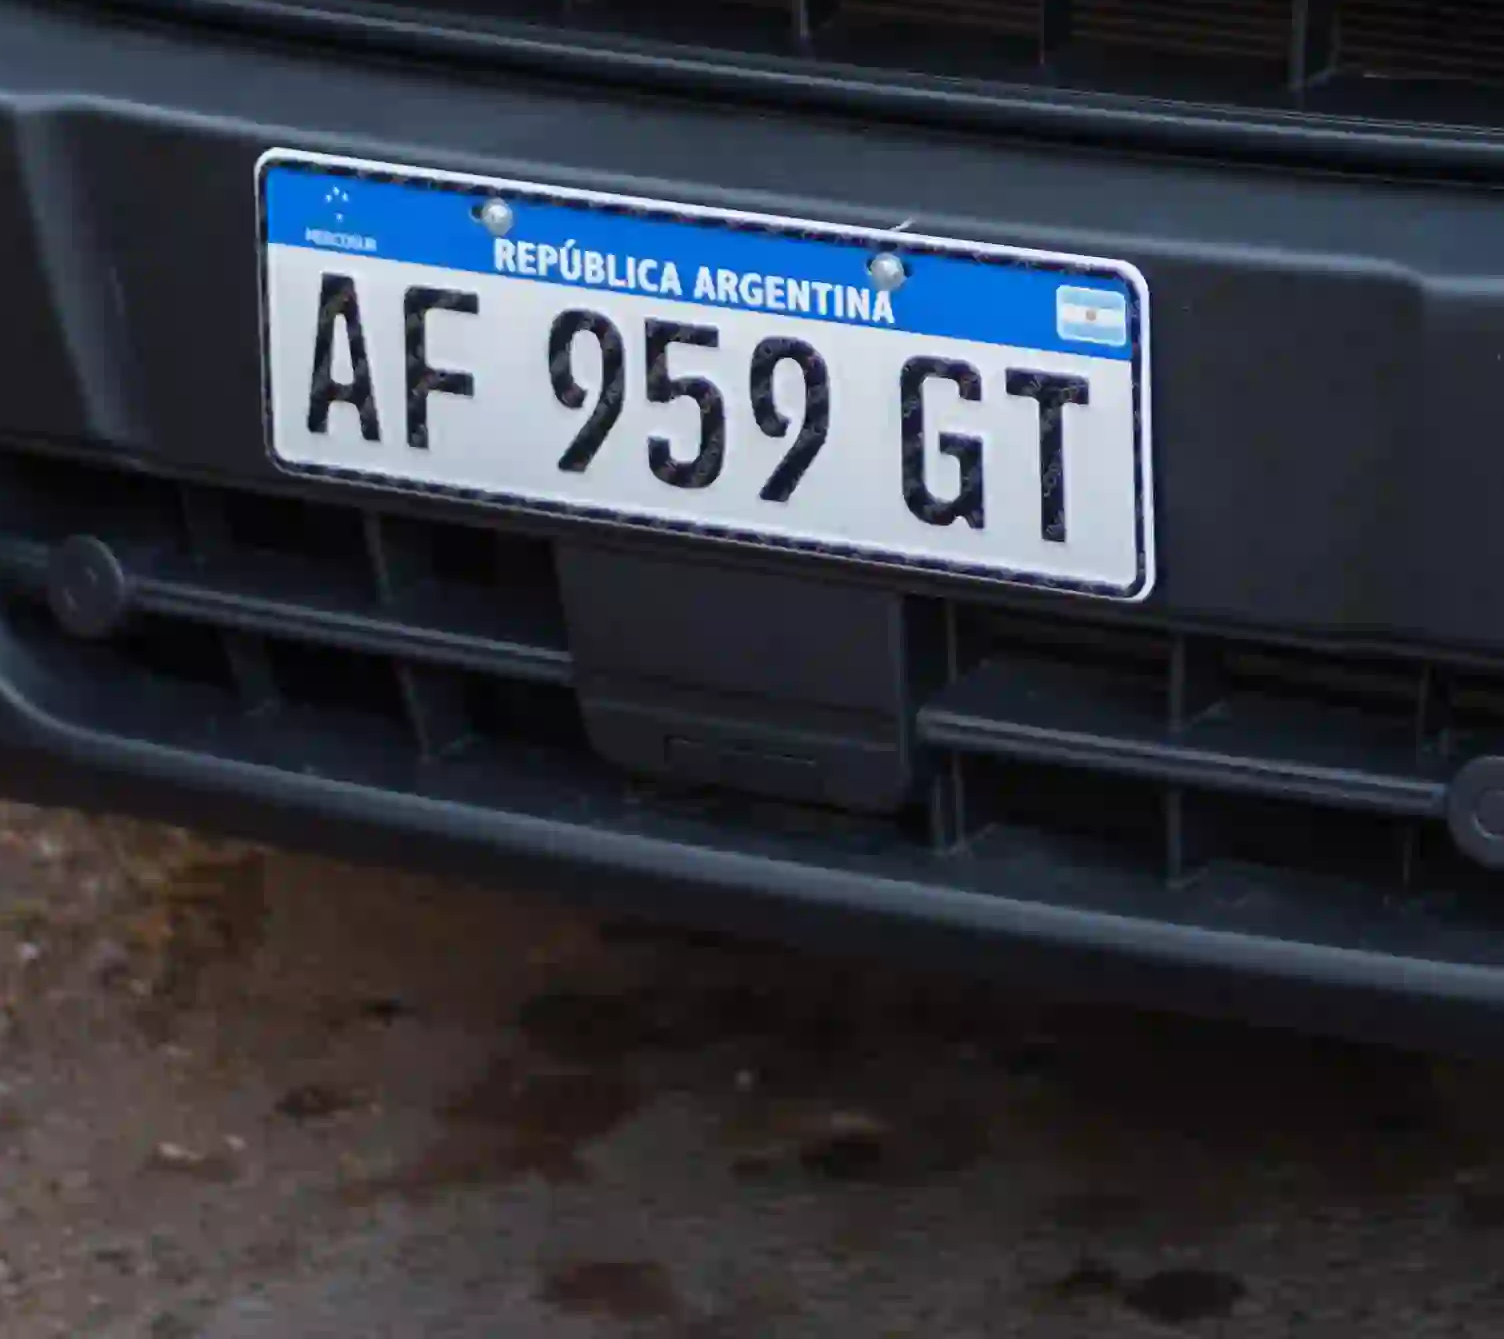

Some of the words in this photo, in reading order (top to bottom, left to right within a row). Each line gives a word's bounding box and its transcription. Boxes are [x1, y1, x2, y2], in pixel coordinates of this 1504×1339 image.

[493, 238, 683, 296] REPÚBLICA
[694, 265, 895, 324] ARGENTINA
[305, 271, 481, 450] AF
[547, 307, 831, 503] 959
[899, 353, 1090, 543] GT
